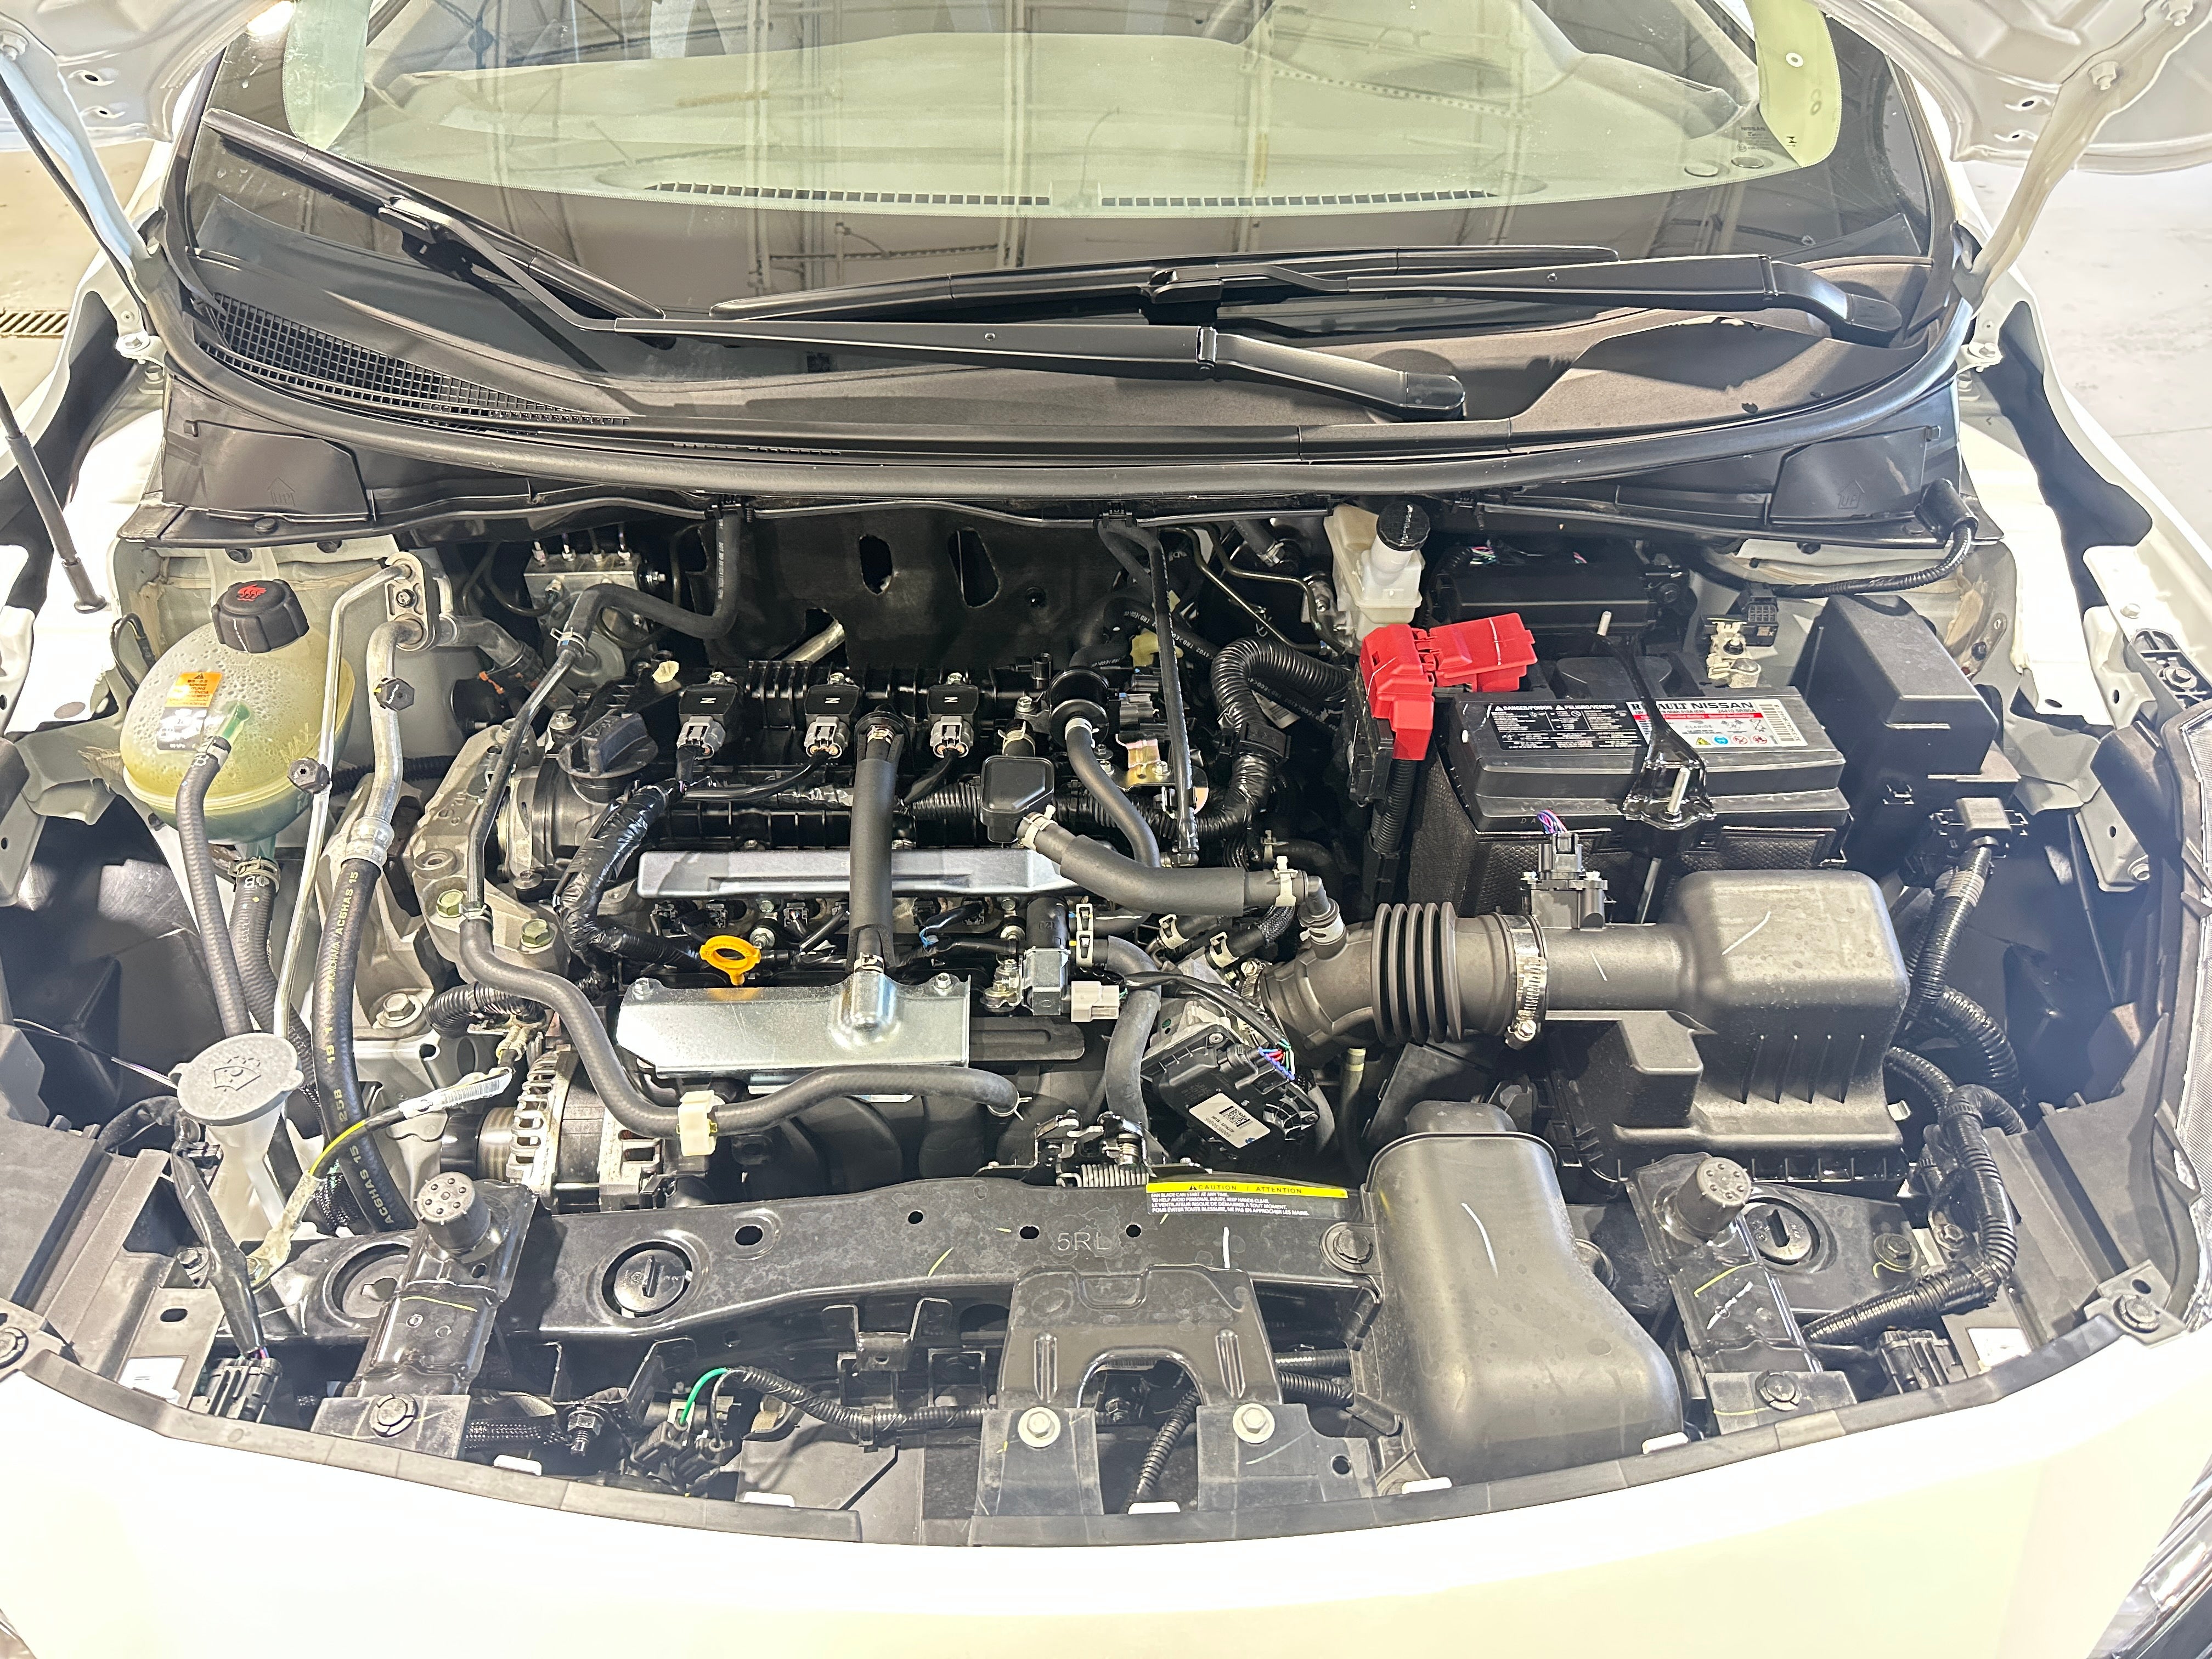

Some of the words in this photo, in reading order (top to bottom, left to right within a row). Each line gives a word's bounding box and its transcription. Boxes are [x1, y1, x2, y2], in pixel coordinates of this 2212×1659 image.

[335, 889, 354, 935] AC6HAS
[349, 871, 359, 884] 15
[349, 1145, 362, 1164] 15
[359, 1168, 394, 1224] AC6HAS
[1058, 1232, 1109, 1251] 5RL
